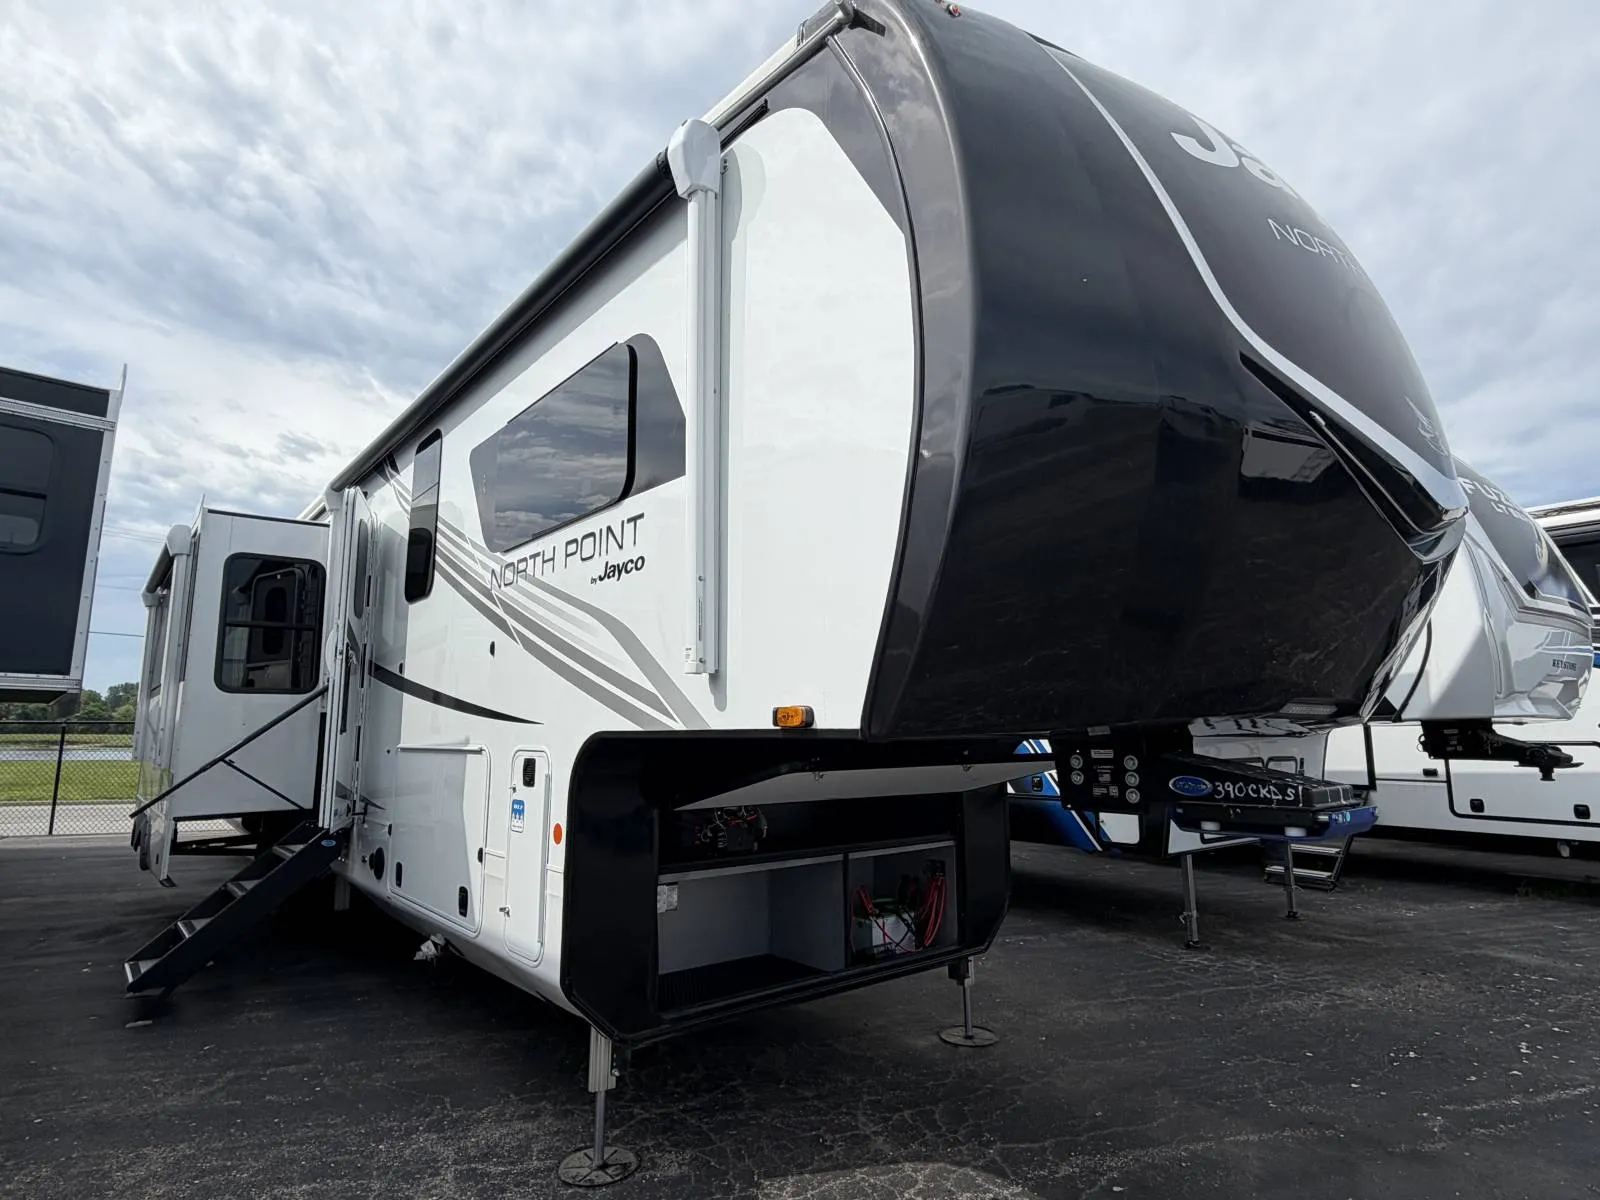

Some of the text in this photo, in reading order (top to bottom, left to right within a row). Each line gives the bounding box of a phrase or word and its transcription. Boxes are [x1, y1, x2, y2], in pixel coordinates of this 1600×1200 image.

[490, 512, 645, 591] NORTH POINT
[590, 555, 646, 585] by Jayco
